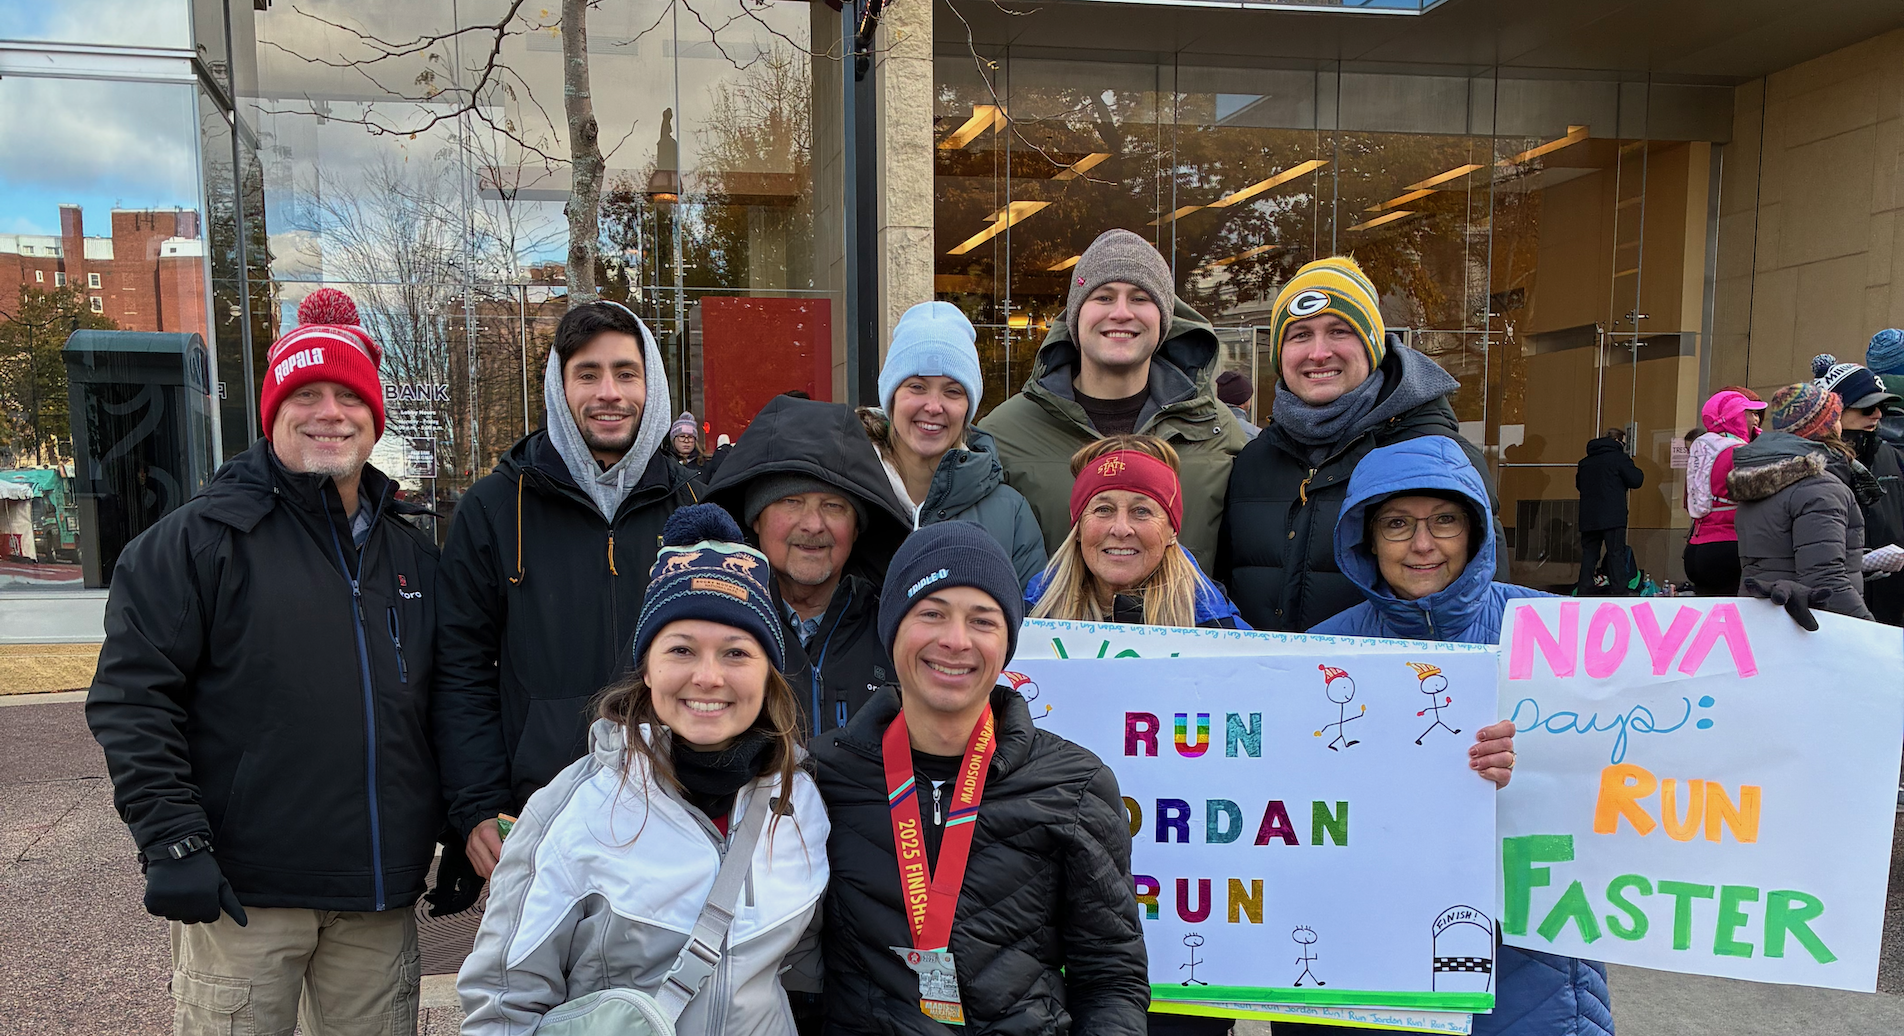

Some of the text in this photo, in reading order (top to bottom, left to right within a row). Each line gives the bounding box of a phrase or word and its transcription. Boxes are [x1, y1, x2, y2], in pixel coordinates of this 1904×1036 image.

[383, 383, 451, 401] BANK
[1508, 601, 1759, 680] NOVA
[1124, 711, 1263, 758] RUN
[960, 754, 984, 804] MADISON
[1593, 763, 1762, 844] RUN
[898, 818, 921, 860] 2025
[1132, 874, 1264, 924] RUN
[1436, 910, 1478, 930] FINISH!
[1502, 834, 1838, 964] FASTER
[1284, 1006, 1319, 1016] Jordan
[1348, 1010, 1367, 1022] Run
[1369, 1013, 1403, 1026] Jordan
[1406, 1017, 1426, 1028] Run!
[1430, 1020, 1446, 1029] Run
